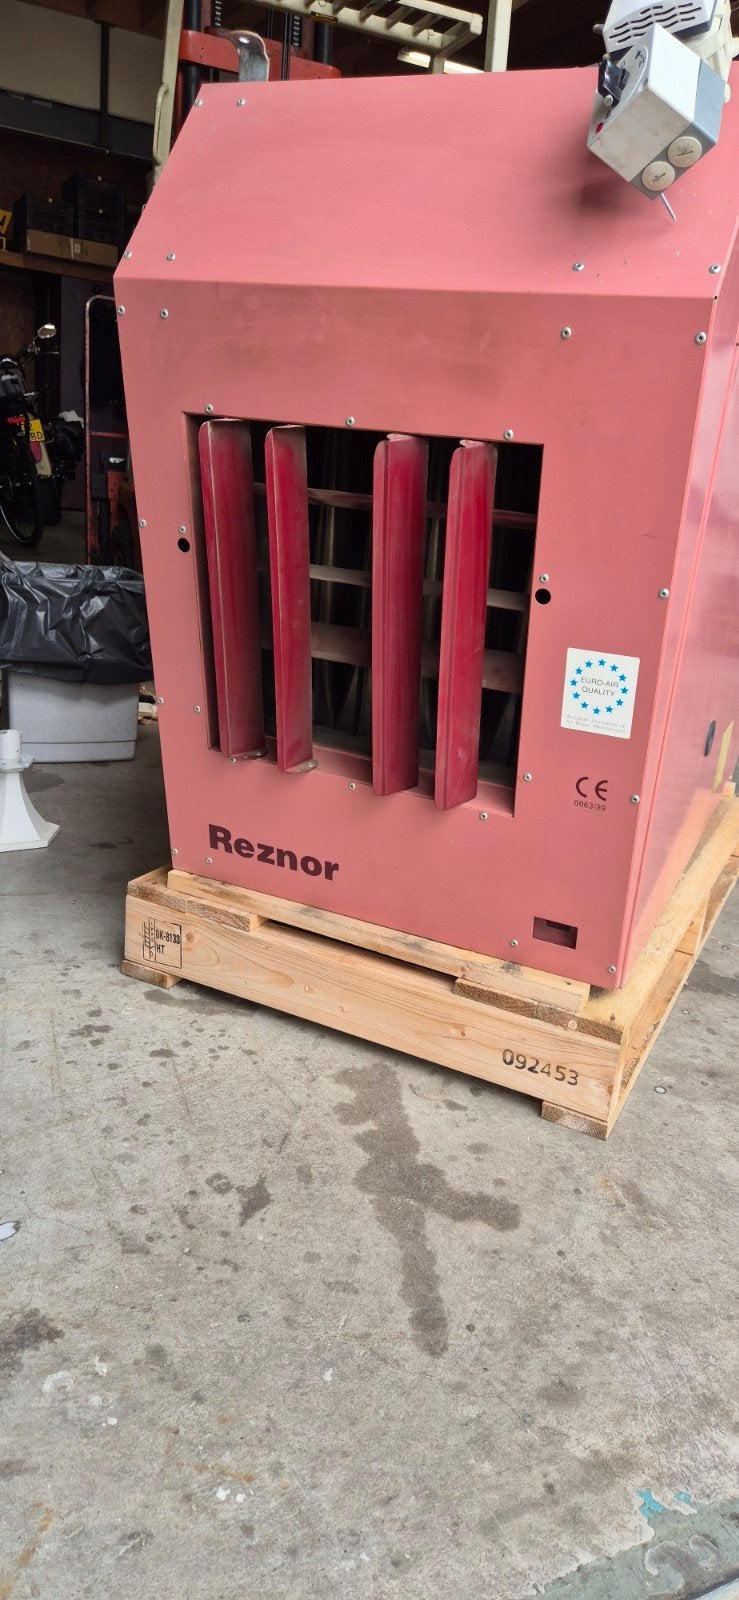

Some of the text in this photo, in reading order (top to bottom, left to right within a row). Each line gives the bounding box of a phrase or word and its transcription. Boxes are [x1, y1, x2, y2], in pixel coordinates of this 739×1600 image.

[580, 676, 619, 688] EURO-AIR
[581, 685, 616, 697] QUALITY
[575, 776, 609, 802] CE
[573, 799, 607, 812] 0063/99
[208, 823, 340, 881] Reznor
[156, 943, 166, 955] HT
[502, 1048, 579, 1086] 092453
